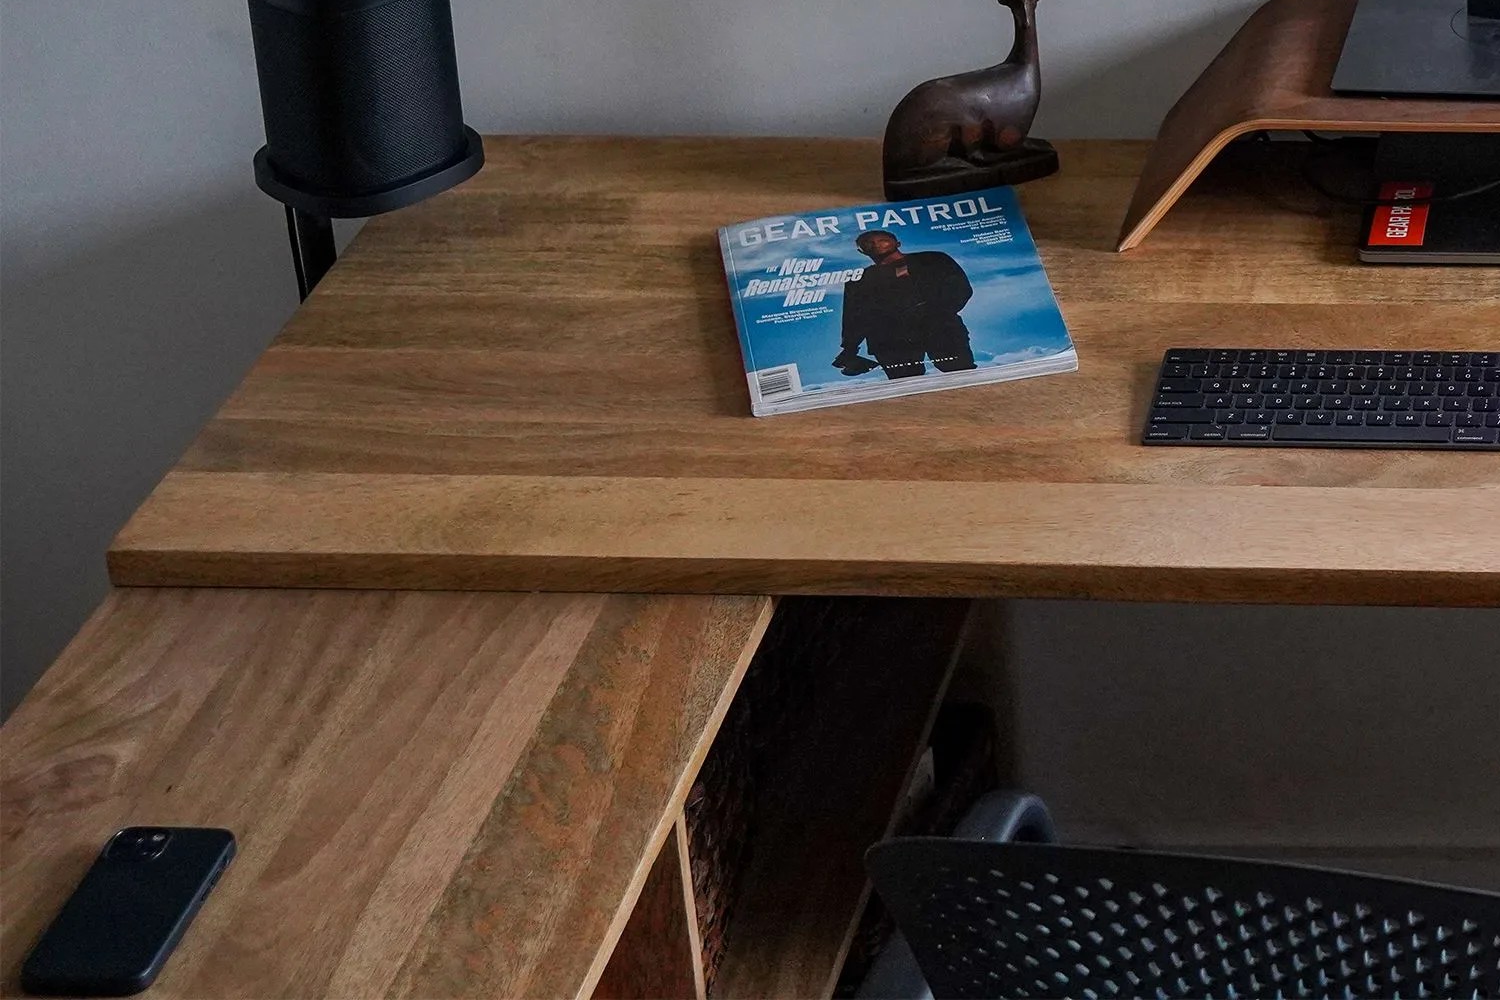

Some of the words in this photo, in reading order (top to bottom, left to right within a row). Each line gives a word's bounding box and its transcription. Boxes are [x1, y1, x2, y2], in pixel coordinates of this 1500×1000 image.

[739, 216, 841, 248] GEAR
[855, 196, 1002, 230] PATROL
[1386, 216, 1410, 238] GEAR
[778, 258, 824, 276] New
[744, 267, 864, 298] Renaissance
[782, 289, 826, 308] Man
